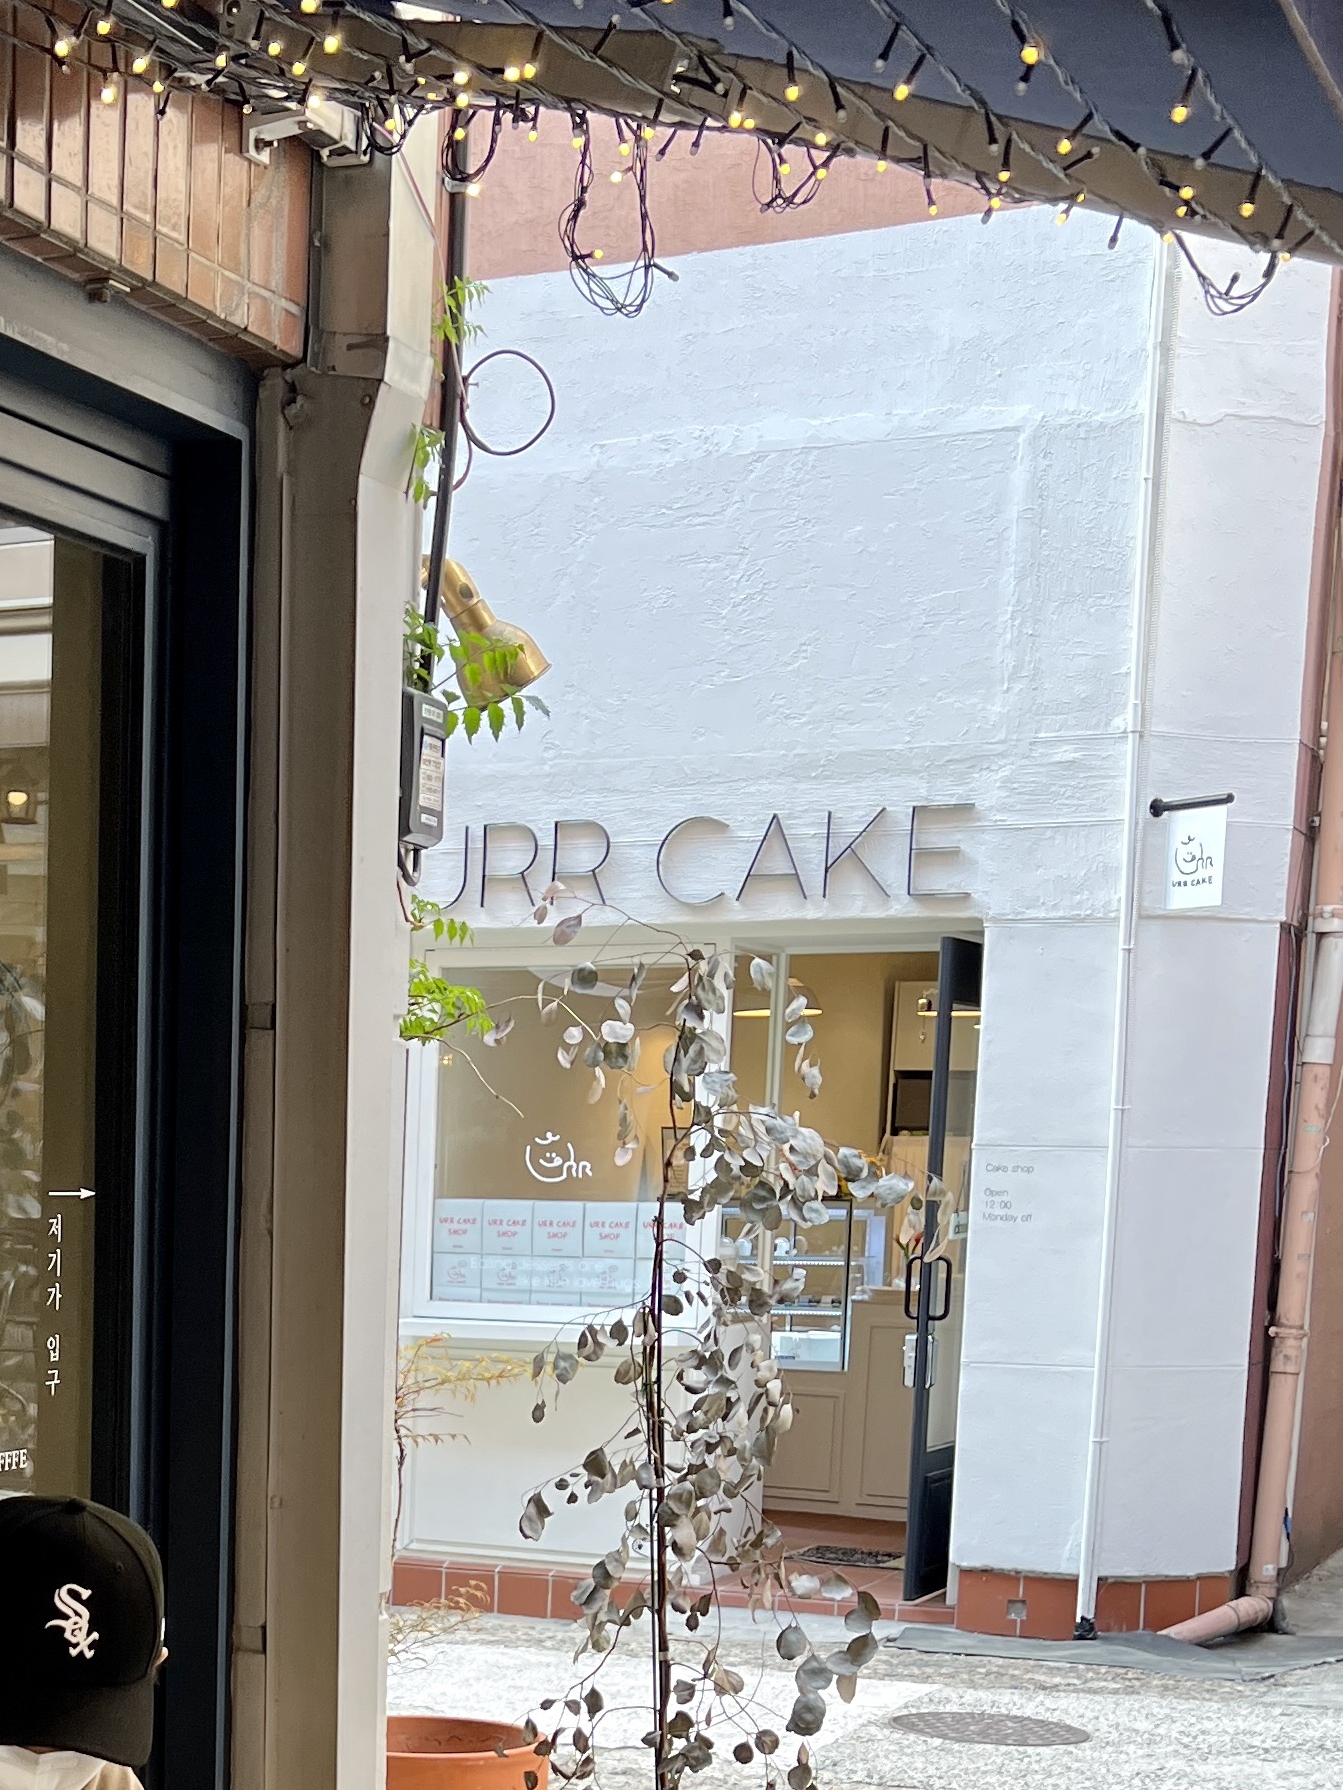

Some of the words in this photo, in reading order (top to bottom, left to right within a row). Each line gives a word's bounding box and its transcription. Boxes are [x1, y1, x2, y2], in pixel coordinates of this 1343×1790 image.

[657, 802, 976, 905] CAKE
[1190, 875, 1213, 887] CAKE
[985, 1163, 1009, 1173] Cake
[1011, 1164, 1035, 1174] shop
[983, 1187, 1009, 1198] Open
[982, 1212, 1019, 1223] Monday
[1020, 1213, 1033, 1223] off
[46, 1213, 63, 1312] 저기가
[45, 1333, 61, 1397] 입구
